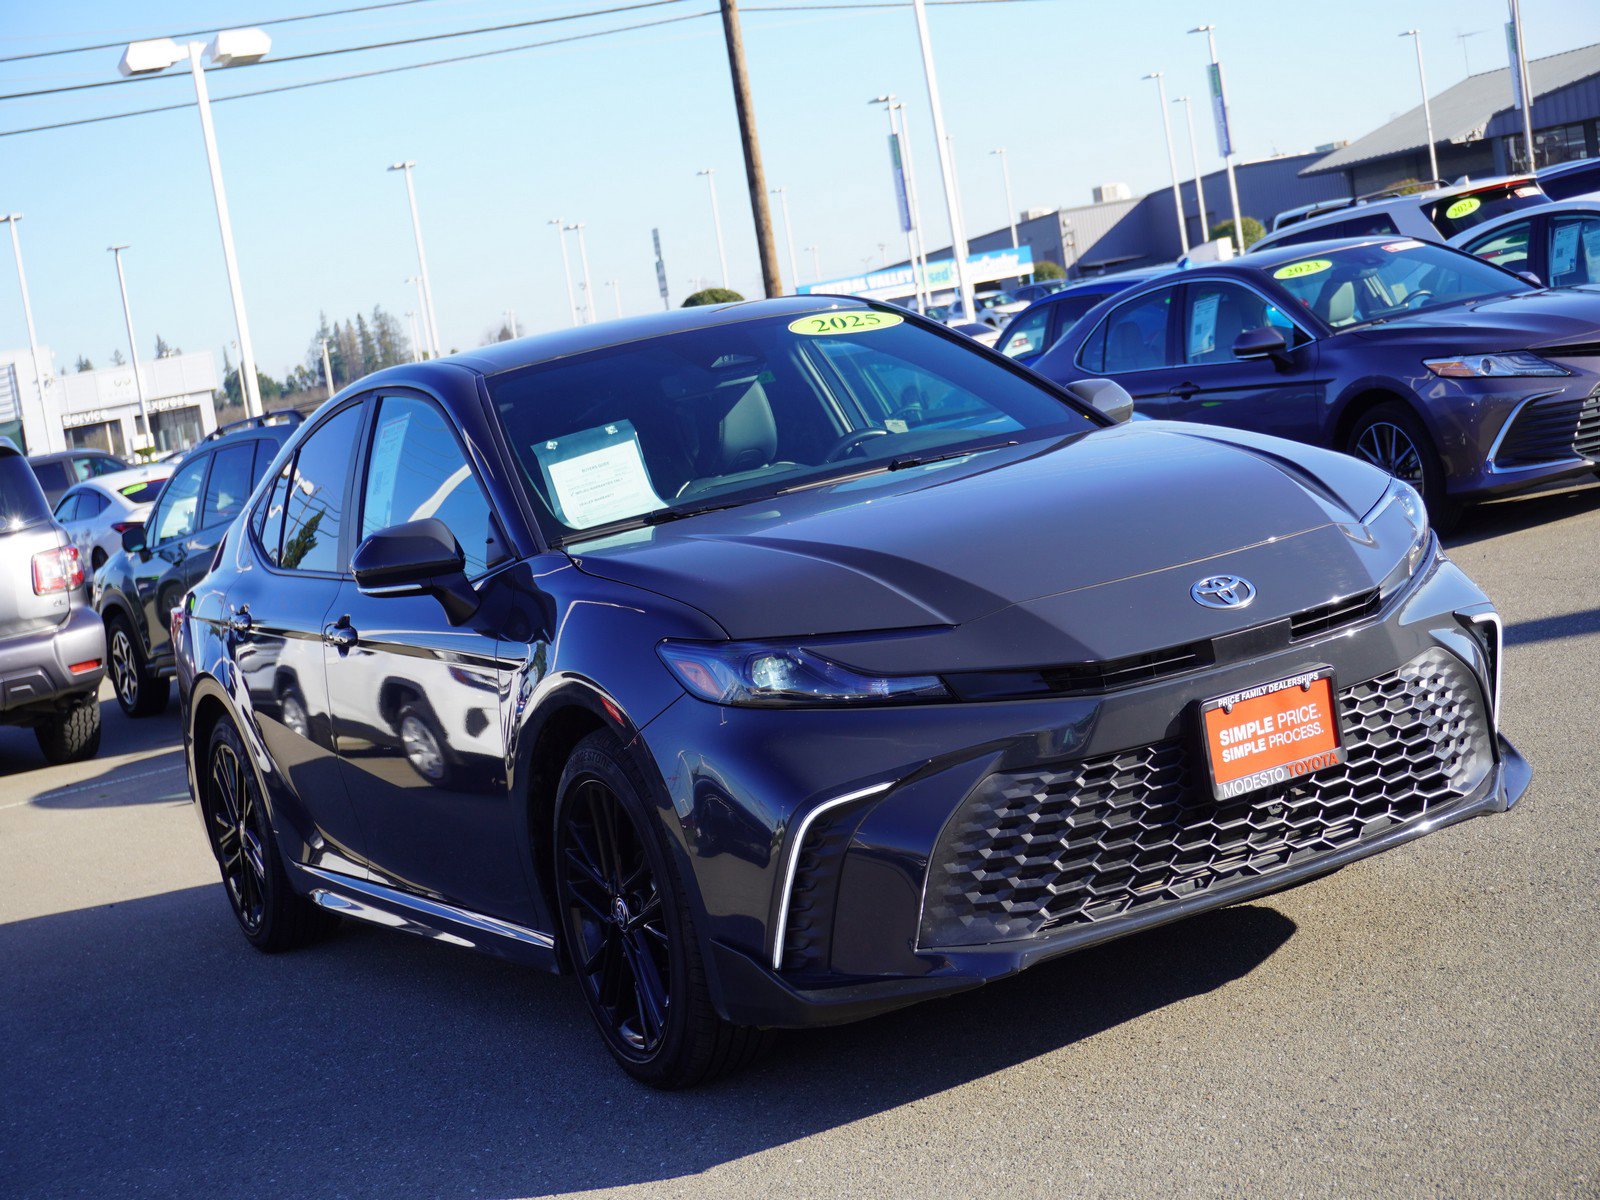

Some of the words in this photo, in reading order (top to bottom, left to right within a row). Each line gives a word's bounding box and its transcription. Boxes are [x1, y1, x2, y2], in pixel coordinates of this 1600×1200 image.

[811, 313, 881, 333] 2025
[62, 409, 108, 426] Service
[1218, 694, 1240, 707] PRICE
[1242, 685, 1267, 700] FAMILY
[1269, 672, 1318, 693] DEALERSHIPS
[1219, 716, 1274, 746] SIMPLE
[1277, 703, 1321, 729] PRICE.
[1221, 738, 1267, 762] SIMPLE
[1269, 722, 1324, 748] PROCESS.
[1223, 768, 1284, 798] MODESTO
[1286, 752, 1339, 778] TOYOTA
